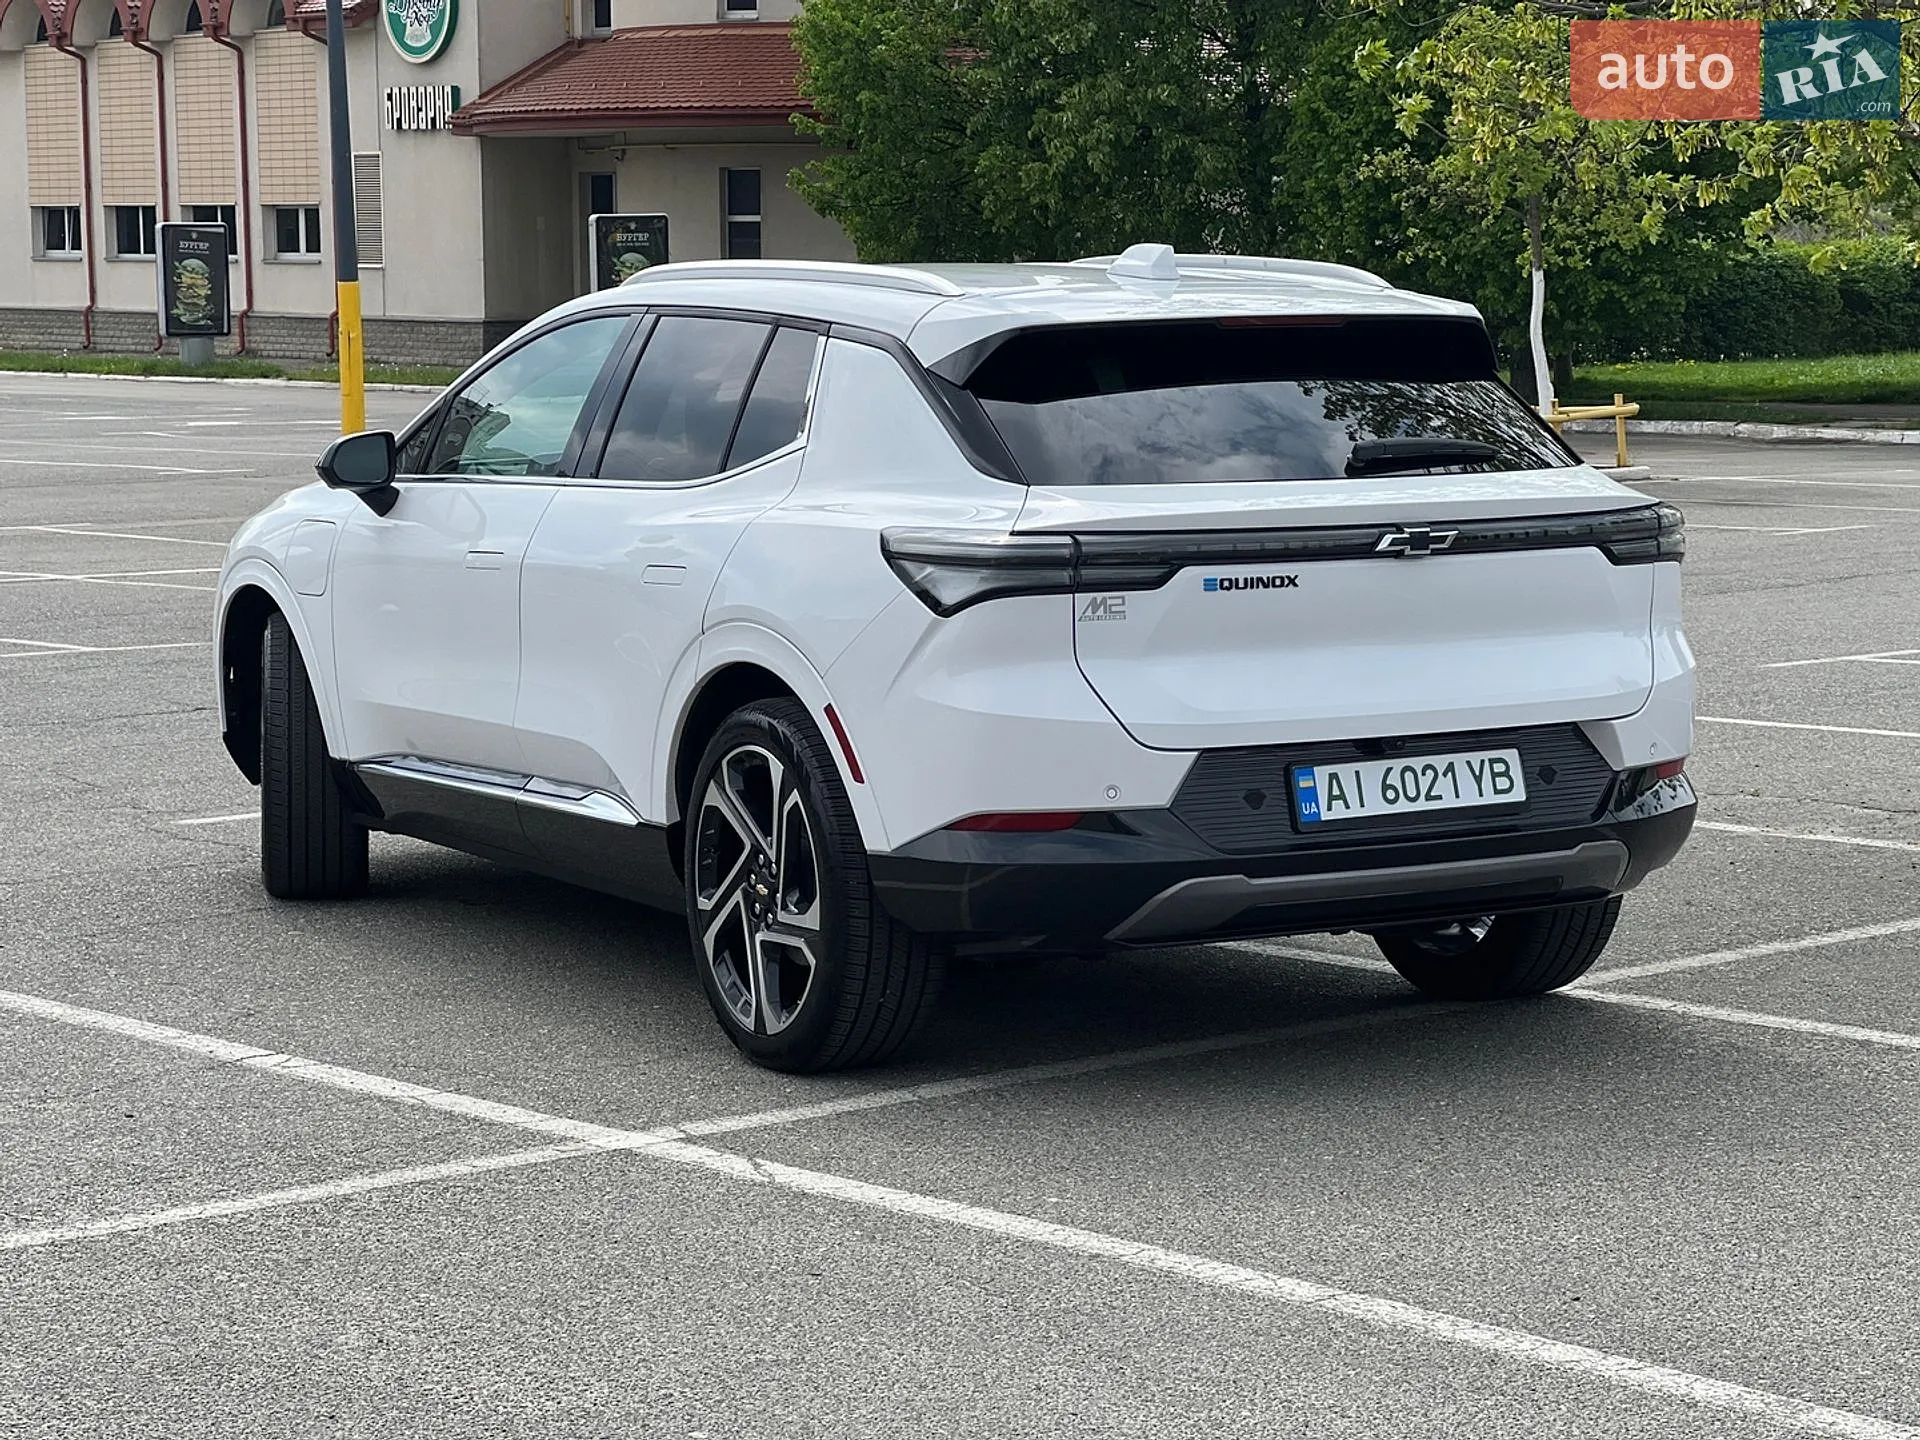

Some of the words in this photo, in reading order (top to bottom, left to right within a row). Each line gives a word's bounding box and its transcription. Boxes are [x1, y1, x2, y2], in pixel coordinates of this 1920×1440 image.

[1203, 574, 1299, 592] EQUINOX
[1326, 769, 1366, 812] AI
[1380, 760, 1461, 806] 6021
[1465, 756, 1515, 798] YB
[1302, 802, 1319, 815] UA
